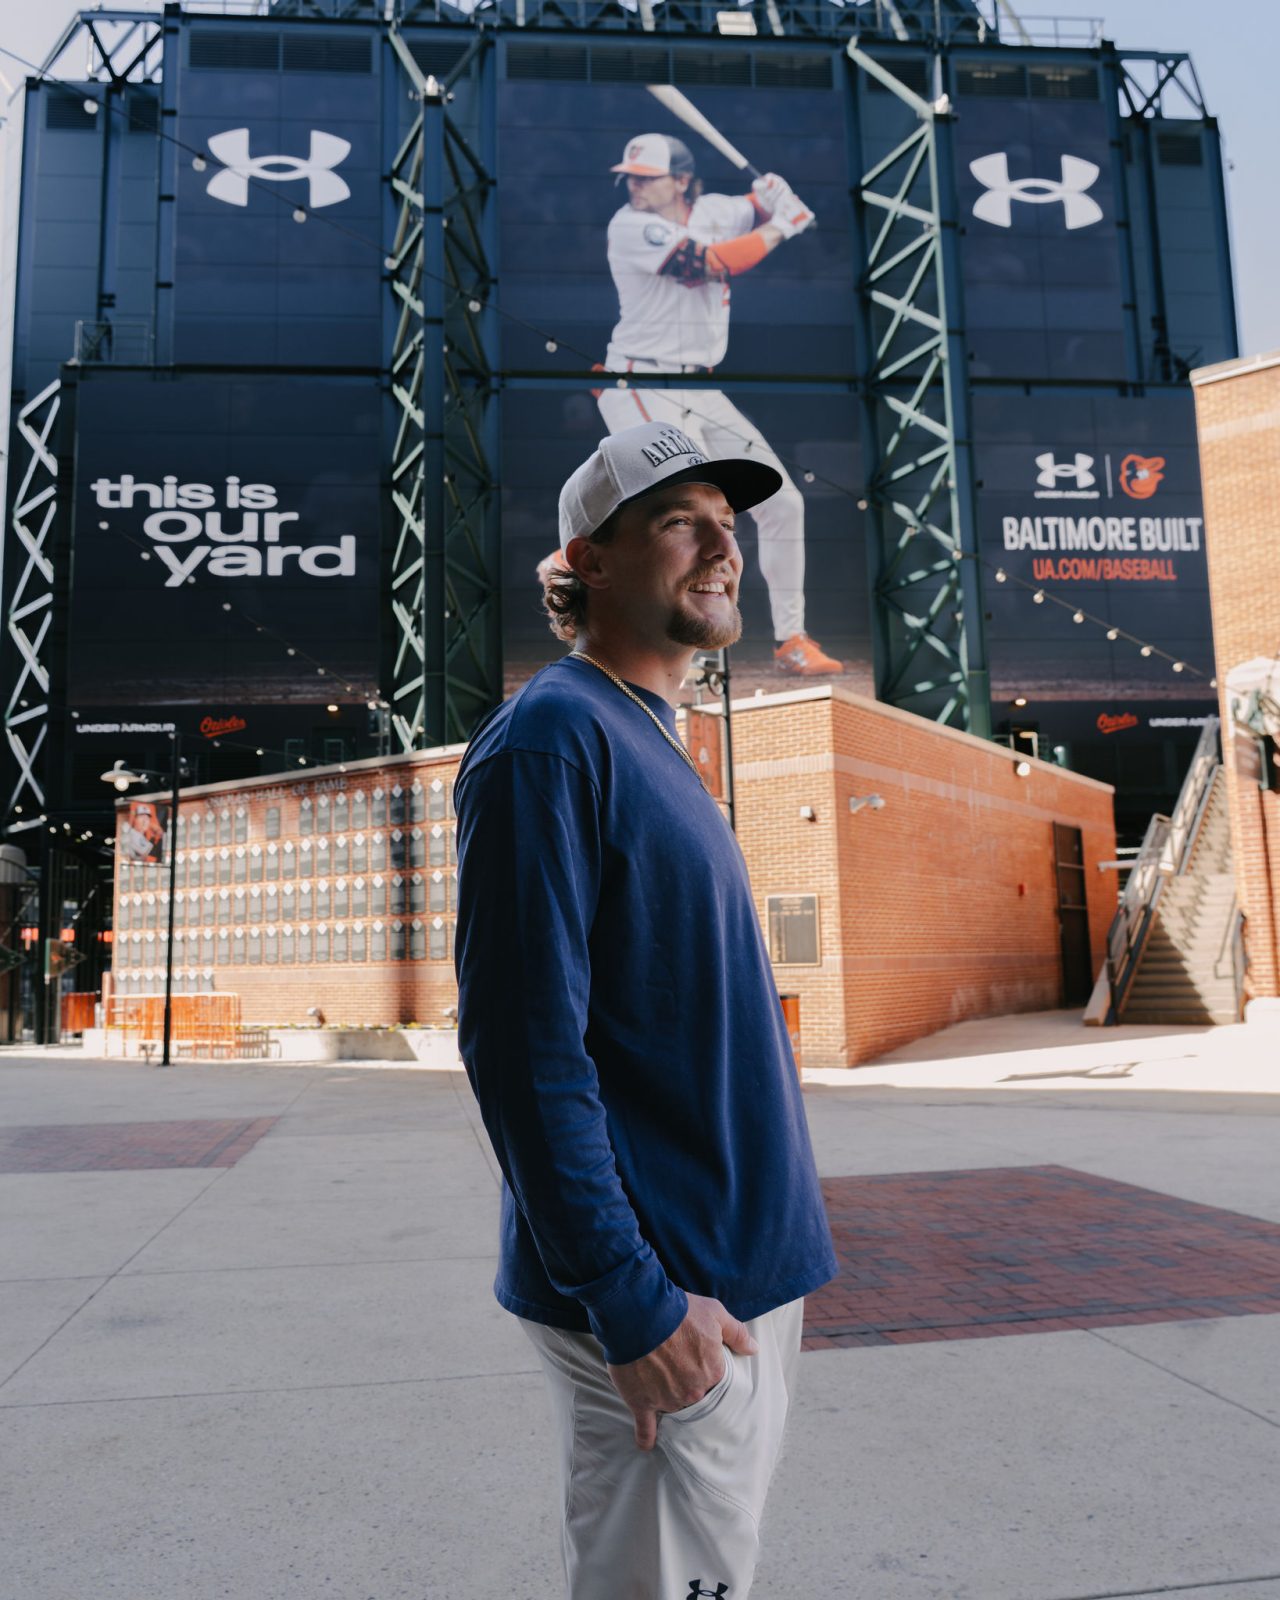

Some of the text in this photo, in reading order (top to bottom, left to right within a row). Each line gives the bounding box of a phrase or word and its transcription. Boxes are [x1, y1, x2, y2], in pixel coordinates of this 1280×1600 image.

[90, 474, 278, 509] this is
[143, 510, 299, 543] our
[1002, 516, 1203, 552] BALTIMORE BUILT
[153, 535, 356, 587] yard
[1032, 558, 1177, 581] UA.COM/BASEBALL
[76, 722, 175, 733] UNDER ARMOUR
[199, 716, 246, 739] Orioles
